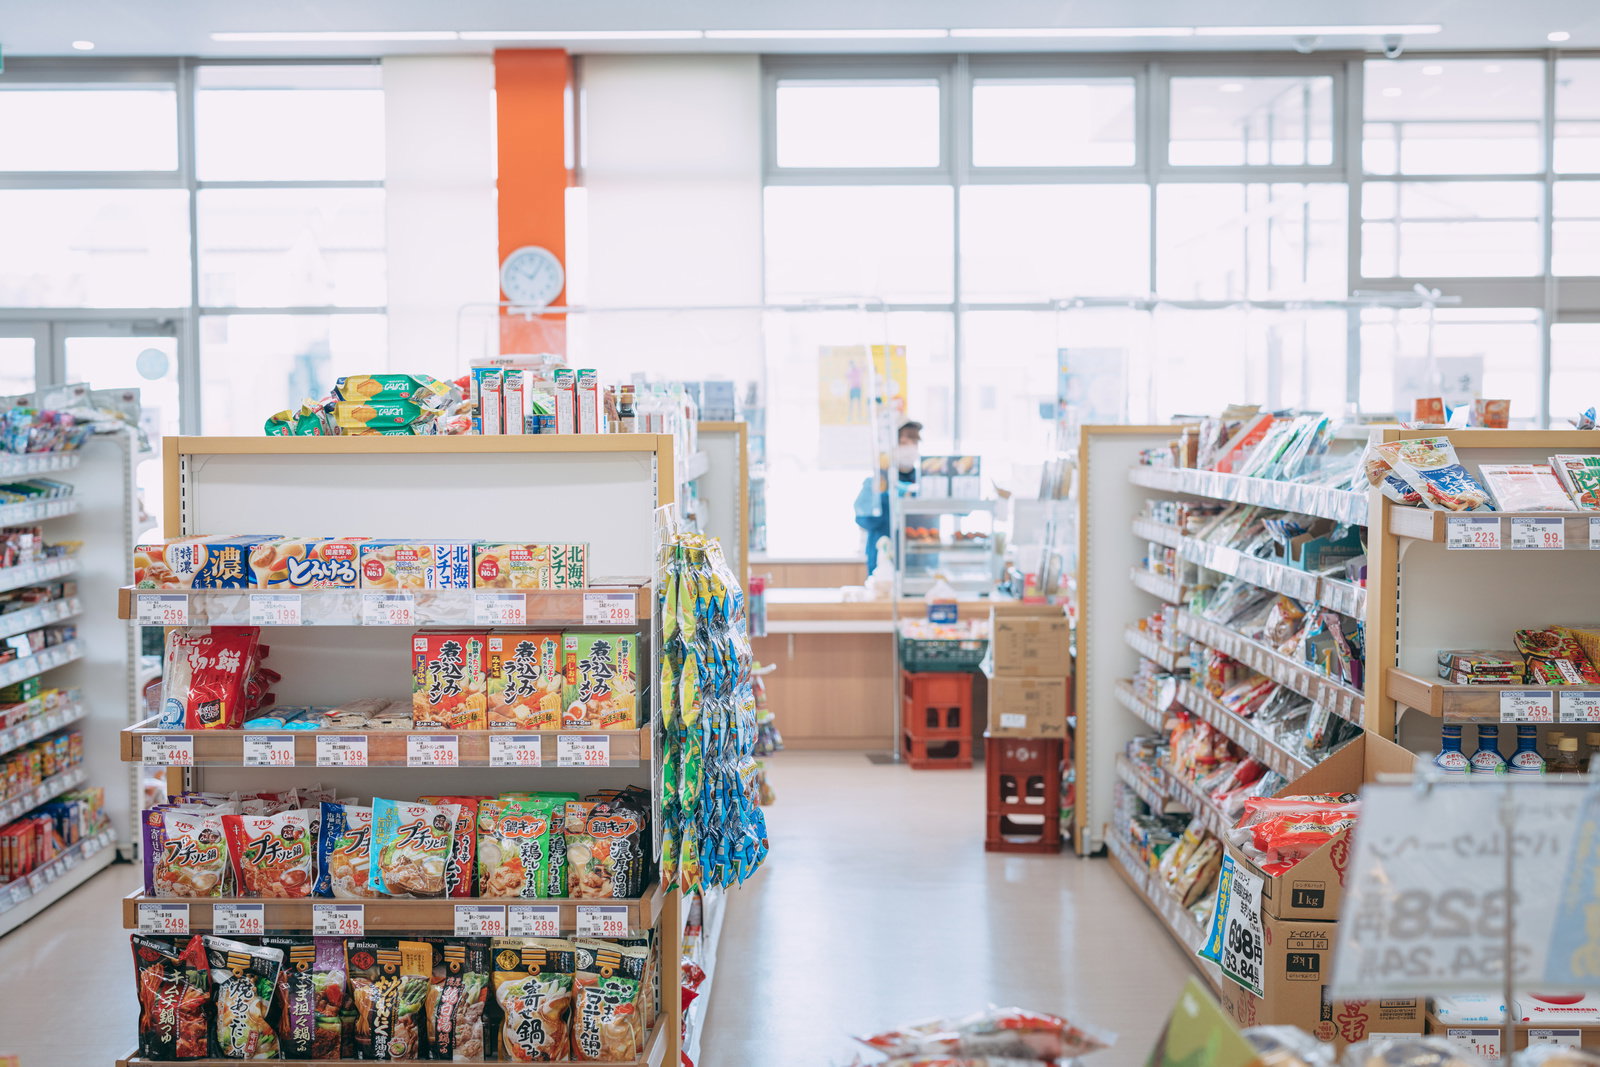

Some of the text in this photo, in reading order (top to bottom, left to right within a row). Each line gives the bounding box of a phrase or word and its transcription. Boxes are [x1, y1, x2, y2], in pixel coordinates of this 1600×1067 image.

[1475, 532, 1495, 542] 223
[1544, 533, 1558, 543] 99
[289, 558, 355, 585] とろける
[436, 546, 450, 588] シチュ
[551, 546, 566, 588] シチュ
[164, 610, 183, 619] 259
[277, 610, 296, 619] 199
[390, 609, 409, 620] 289
[502, 609, 521, 619] 289
[611, 608, 630, 618] 289
[189, 647, 240, 674] 切り餅
[439, 641, 463, 696] 煮込み
[514, 640, 538, 697] 煮込み
[589, 640, 613, 695] 煮込み
[429, 661, 442, 704] ラーメン
[504, 661, 517, 704] ラーメン
[579, 660, 592, 703] ラーメン
[1528, 706, 1548, 716] 259
[169, 750, 188, 760] 449
[270, 750, 290, 760] 310
[343, 750, 363, 760] 139
[434, 750, 453, 760] 329
[516, 750, 536, 760] 329
[585, 750, 604, 760] 329
[175, 821, 195, 830] エバラ
[253, 820, 275, 828] エバラ
[504, 819, 543, 833] 鍋キューブ
[592, 821, 632, 833] 鍋キューブ
[250, 834, 302, 864] プチッと鍋
[520, 840, 543, 898] 鶏だしうま塩
[610, 840, 633, 897] 濃厚白湯
[165, 918, 184, 928] 249
[240, 919, 259, 929] 249
[340, 920, 359, 929] 249
[481, 921, 500, 930] 289
[535, 921, 554, 931] 289
[604, 921, 623, 931] 289
[1229, 918, 1262, 966] 698円
[159, 970, 184, 1044] キムチ鍋つゆ
[516, 979, 546, 1058] 寄せ鍋つゆ
[1476, 1044, 1495, 1055] 115
